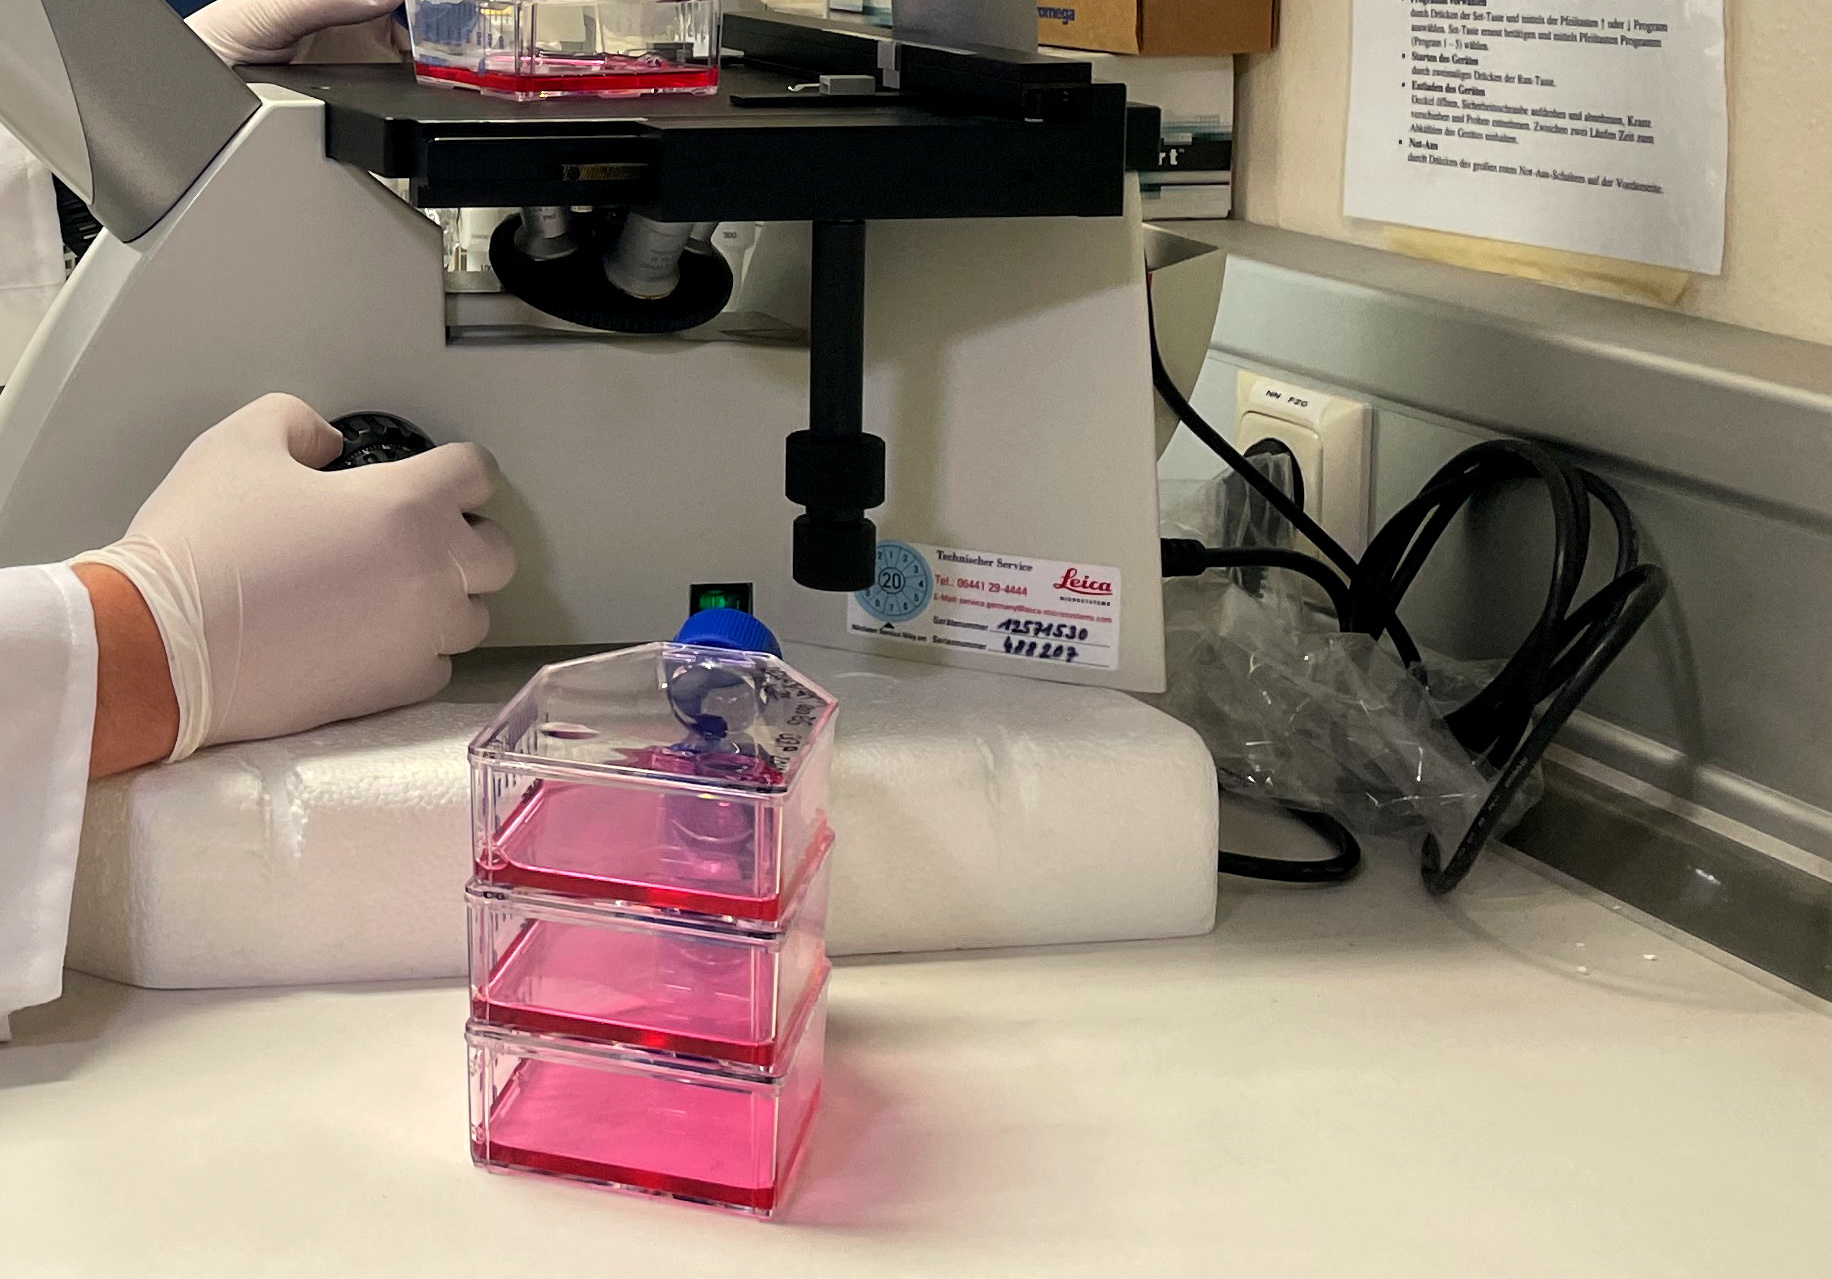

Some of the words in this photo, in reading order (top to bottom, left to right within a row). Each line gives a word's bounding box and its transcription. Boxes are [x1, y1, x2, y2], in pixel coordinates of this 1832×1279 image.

[1037, 6, 1076, 26] omega
[936, 550, 994, 568] Technischer
[996, 559, 1033, 572] Service
[882, 572, 902, 589] 20
[1052, 567, 1113, 596] Leica
